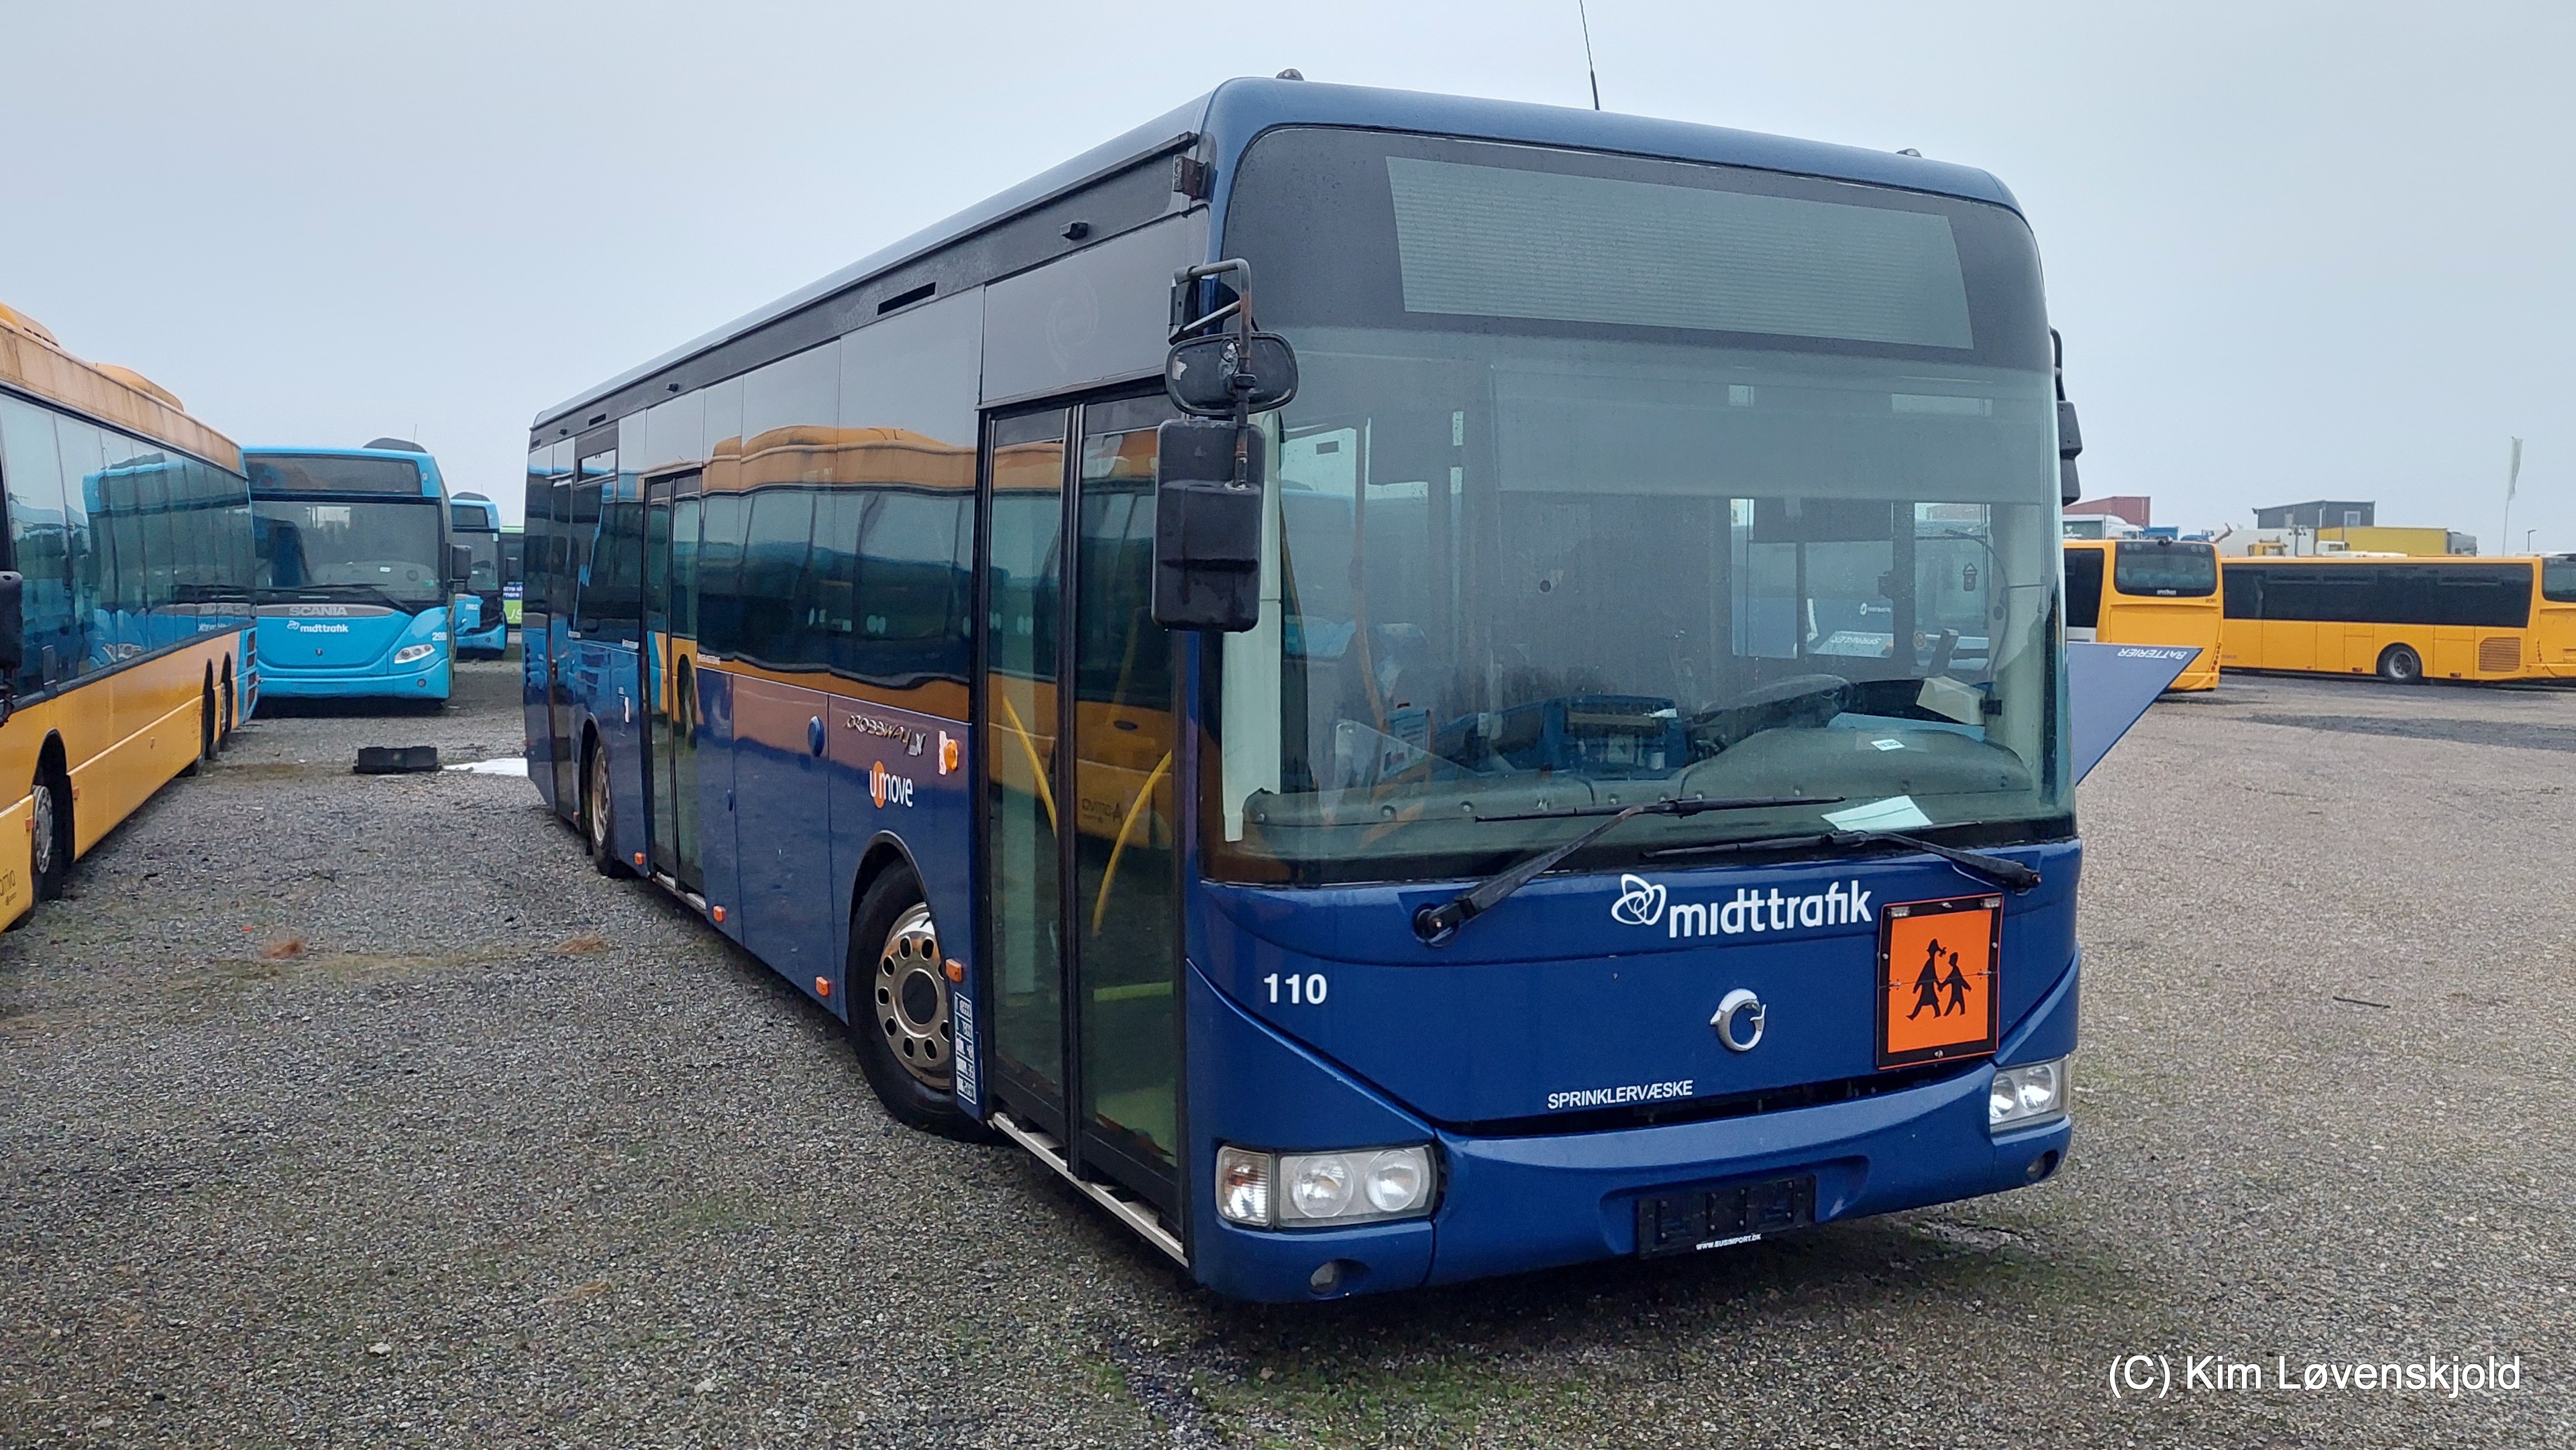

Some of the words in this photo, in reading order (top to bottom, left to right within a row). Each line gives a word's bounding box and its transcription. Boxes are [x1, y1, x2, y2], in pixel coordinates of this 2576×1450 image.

[288, 606, 348, 616] SCANIA
[300, 623, 349, 632] midttrafik
[2117, 648, 2188, 660] BATTERIER
[1669, 879, 1872, 938] midttrafik
[1264, 973, 1327, 1005] 110
[1548, 1080, 1694, 1109] SPRINKLERVÆSKE
